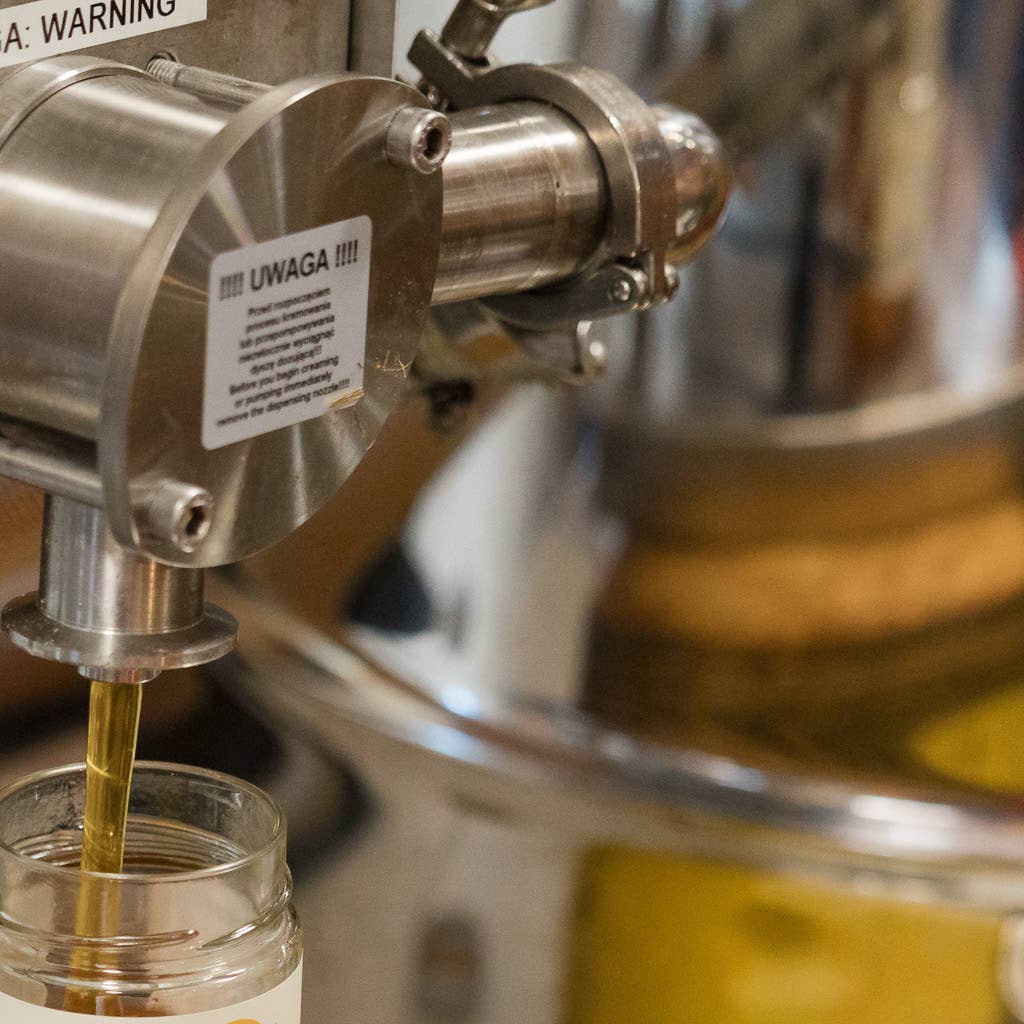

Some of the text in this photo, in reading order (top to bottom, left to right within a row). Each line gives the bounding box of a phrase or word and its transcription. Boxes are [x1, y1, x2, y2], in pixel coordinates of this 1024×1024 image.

[250, 249, 329, 292] UWAGA
[336, 240, 358, 268] !!!!
[276, 368, 299, 381] begin
